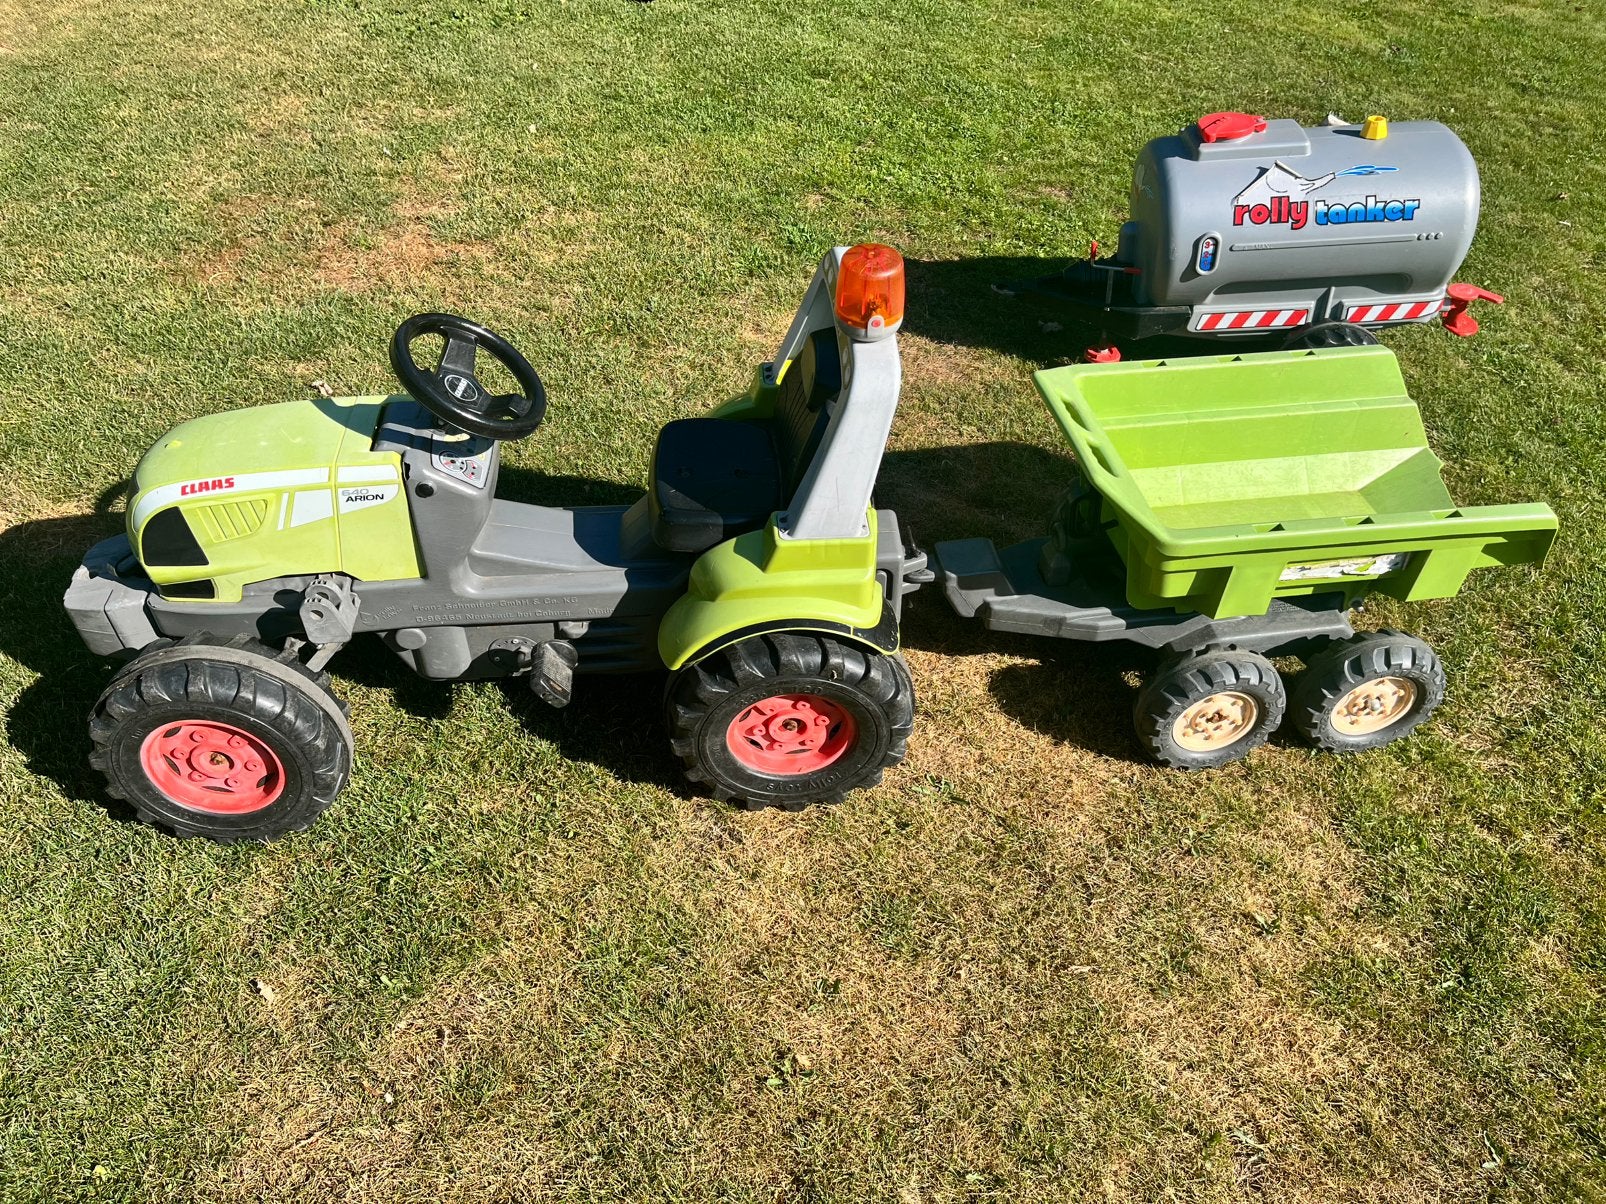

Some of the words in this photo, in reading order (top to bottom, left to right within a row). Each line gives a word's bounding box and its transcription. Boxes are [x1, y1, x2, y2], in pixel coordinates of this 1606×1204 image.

[1233, 195, 1309, 230] rolly
[1315, 195, 1421, 226] tanker
[180, 477, 235, 496] CLAAS
[341, 488, 370, 498] 640
[345, 493, 385, 503] ARION
[444, 600, 496, 611] Schneider
[498, 598, 530, 608] GmbH
[543, 597, 560, 606] Co.
[562, 596, 579, 605] KG
[465, 611, 515, 621] Neustadt
[516, 610, 532, 619] bei
[534, 609, 572, 619] Coburg
